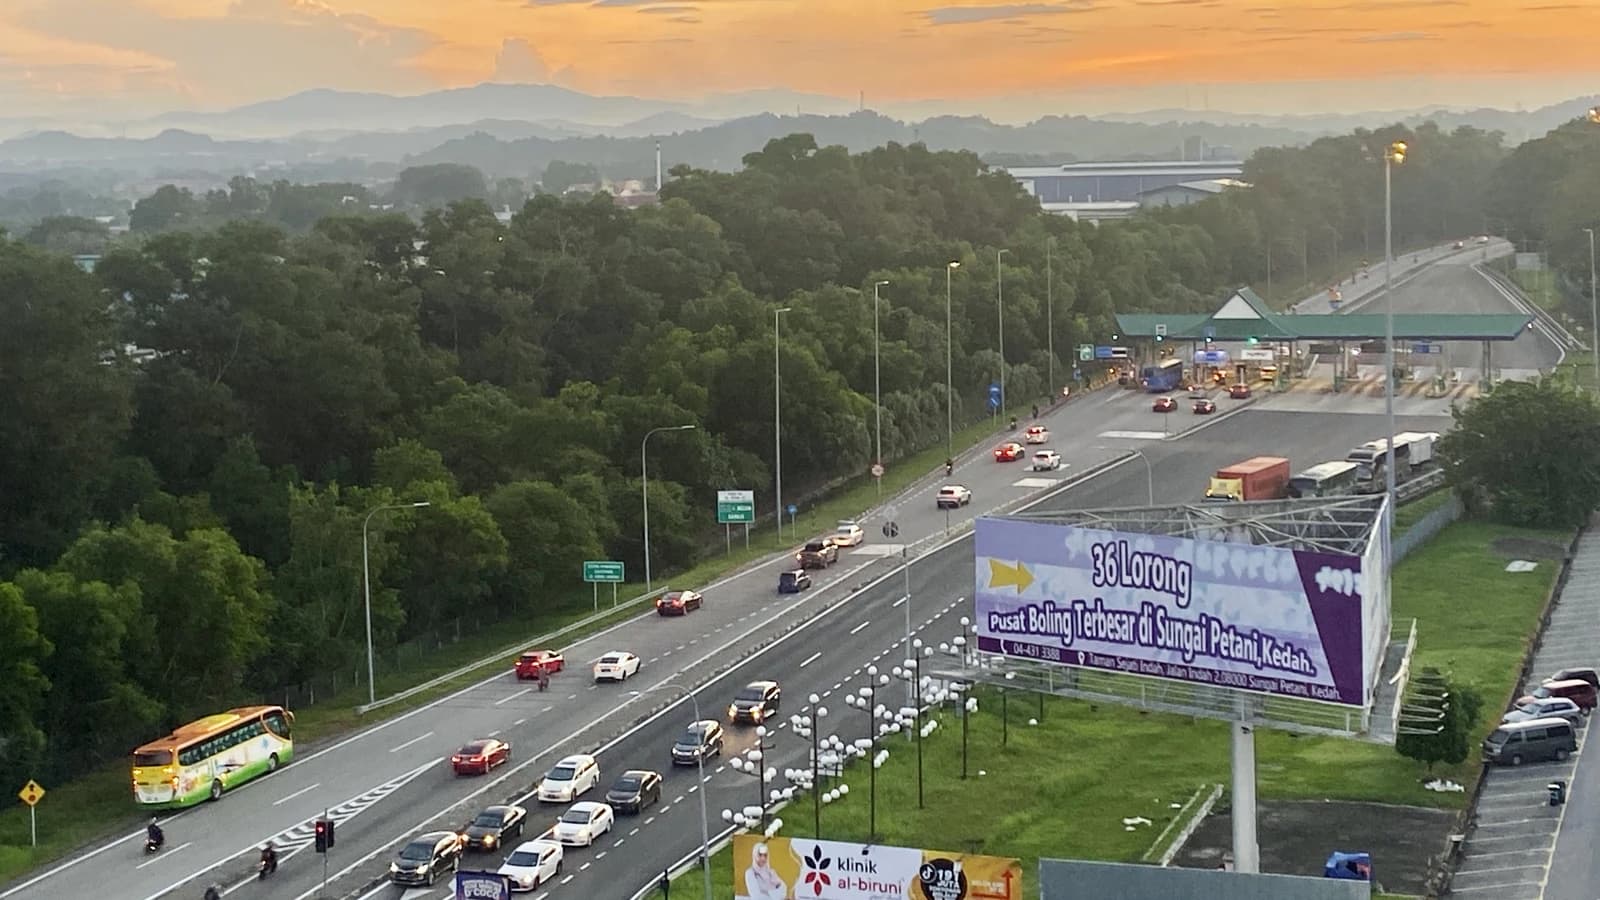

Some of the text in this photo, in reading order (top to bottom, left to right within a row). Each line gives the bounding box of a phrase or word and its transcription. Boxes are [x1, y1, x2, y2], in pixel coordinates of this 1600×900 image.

[1093, 543, 1118, 586] 36
[1120, 542, 1191, 606] Lorong
[990, 608, 1026, 632] Pusat
[1028, 602, 1072, 645] Boling
[1074, 600, 1136, 642] Terbesar
[1138, 603, 1154, 645] di
[1156, 608, 1207, 661] Sungai
[1013, 643, 1040, 656] 04-431
[1089, 653, 1115, 667] Taman
[1167, 664, 1187, 678] Jalan
[1249, 676, 1279, 693] Sungai
[838, 857, 877, 874] klinik
[838, 877, 902, 895] al-biruni
